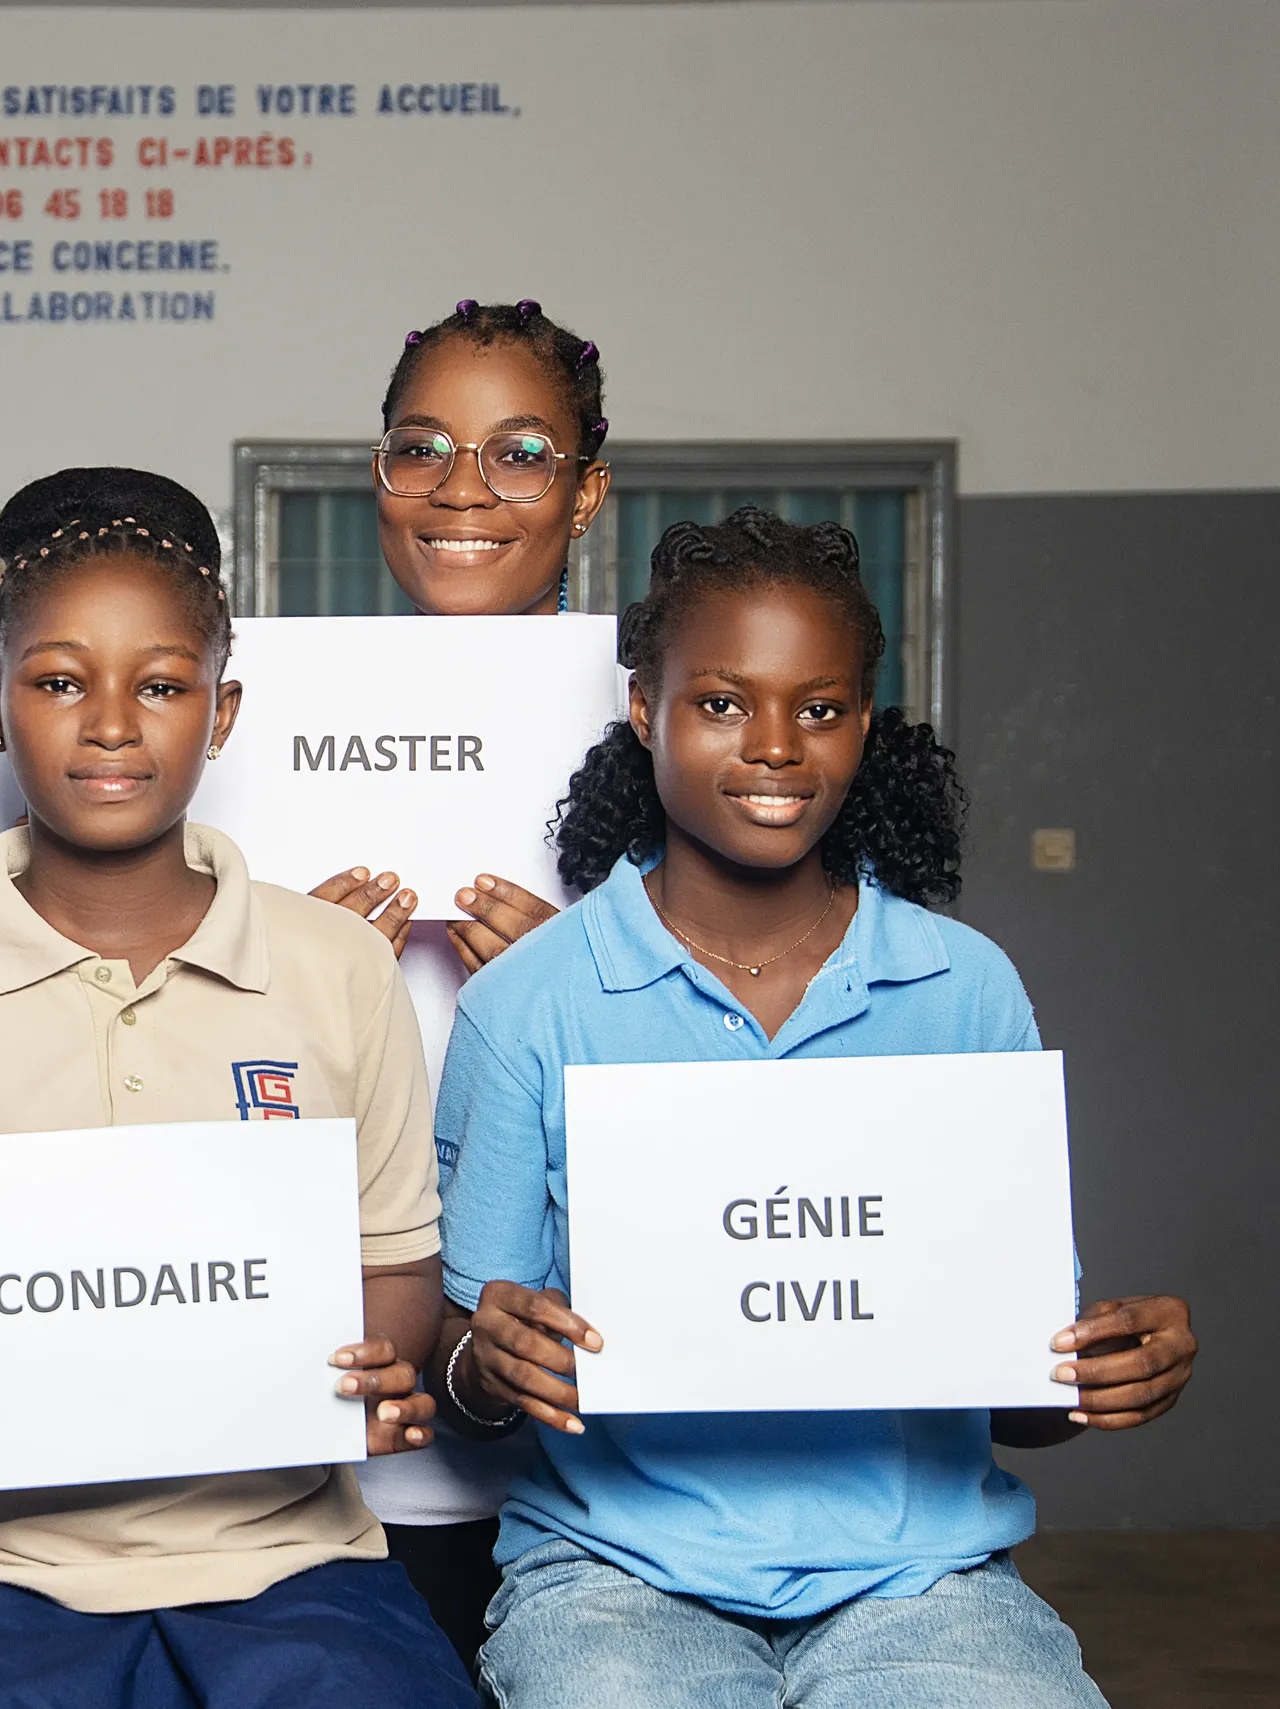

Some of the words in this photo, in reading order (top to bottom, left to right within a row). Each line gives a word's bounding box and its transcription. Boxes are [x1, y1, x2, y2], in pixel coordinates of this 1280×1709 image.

[3, 85, 175, 118] SATISFAITS
[197, 85, 235, 117] DE
[258, 84, 356, 117] VOTRE
[43, 187, 83, 222] 45
[98, 187, 129, 221] 18
[145, 187, 175, 221] 18
[293, 735, 485, 773] MASTER
[722, 1185, 884, 1241] GÉNIE
[740, 1279, 874, 1323] CIVIL
